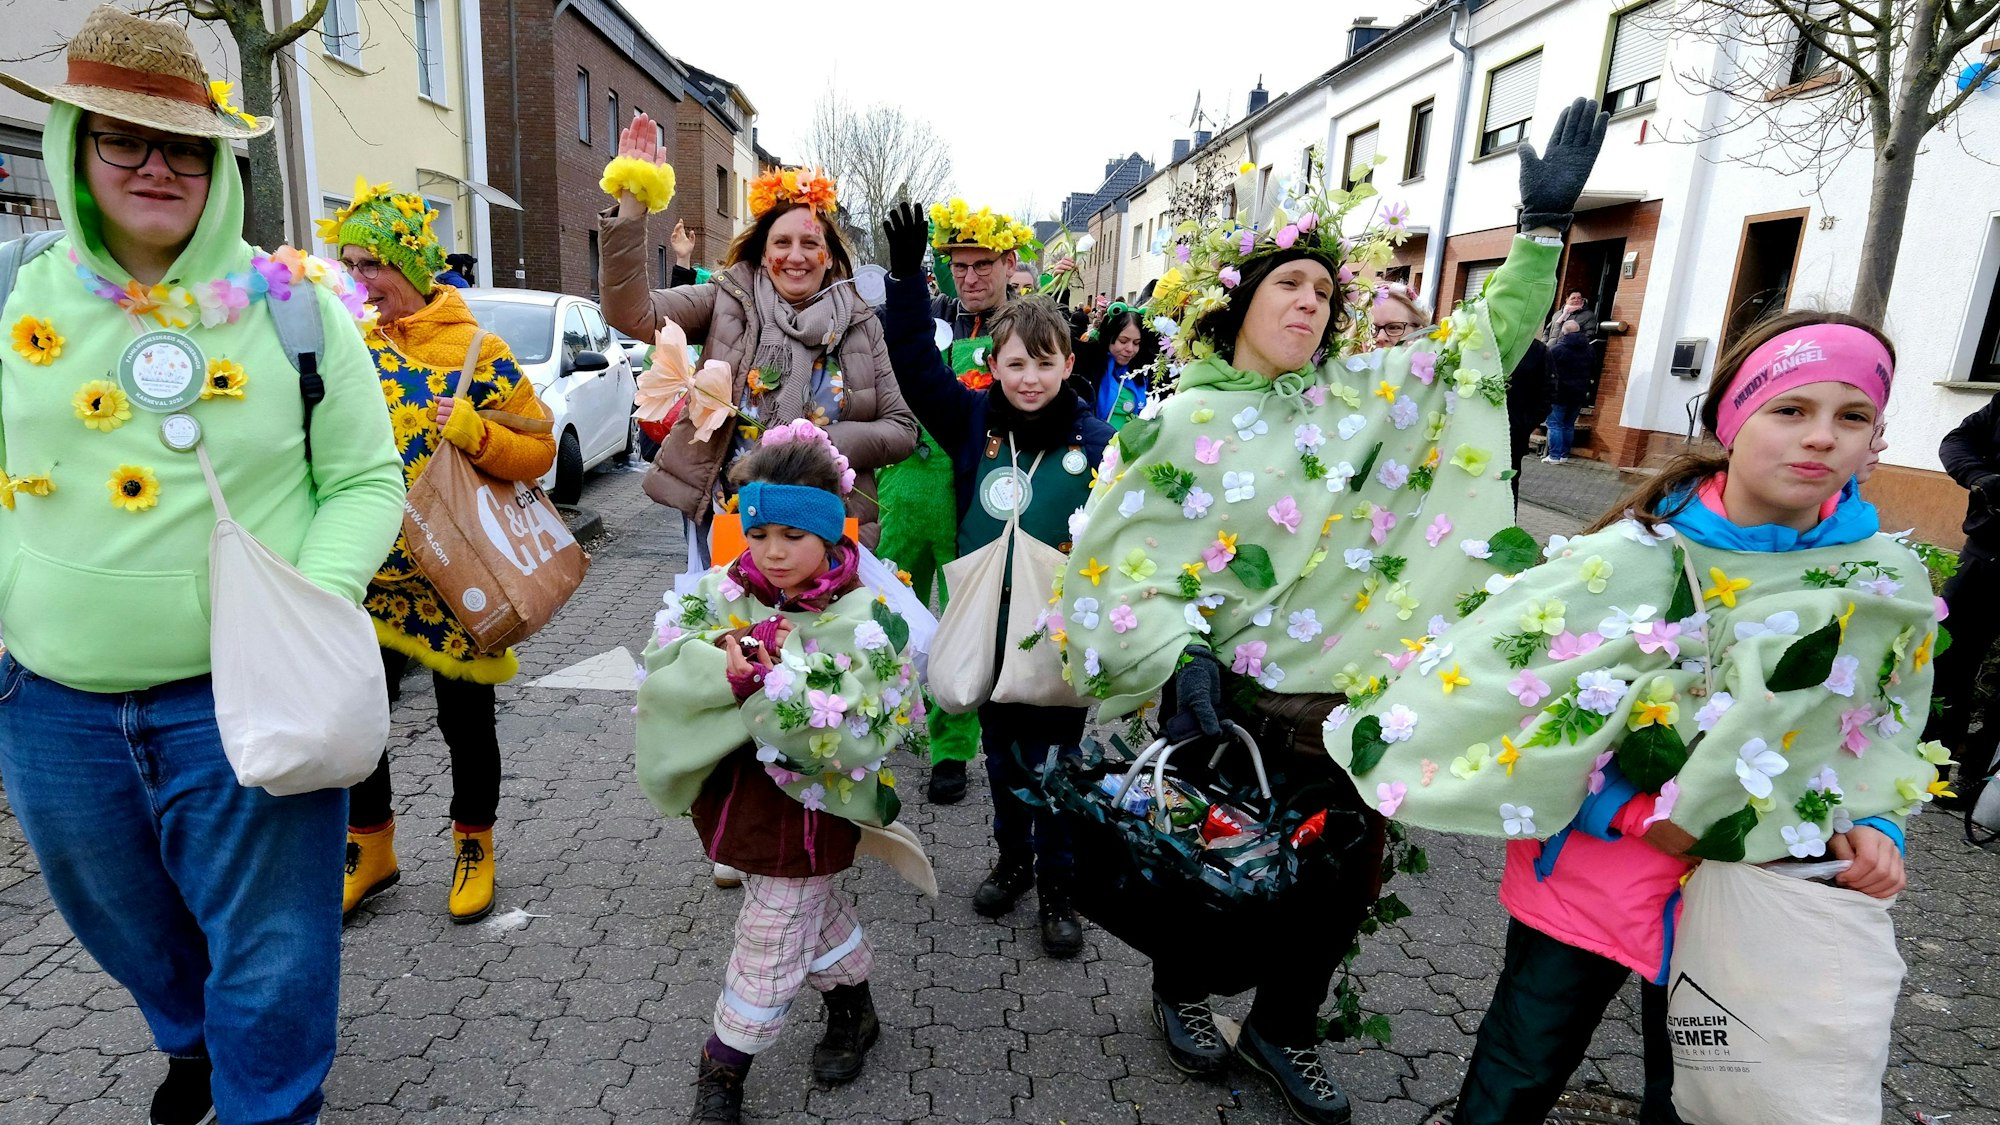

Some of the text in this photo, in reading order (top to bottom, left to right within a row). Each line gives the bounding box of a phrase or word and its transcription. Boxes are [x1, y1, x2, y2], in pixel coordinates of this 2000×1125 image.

[135, 392, 168, 406] KARNEVAL
[1734, 369, 1768, 410] MUDDY
[1772, 348, 1827, 377] ANGEL
[404, 501, 450, 567] ww.c-a.com
[476, 480, 577, 577] C&A
